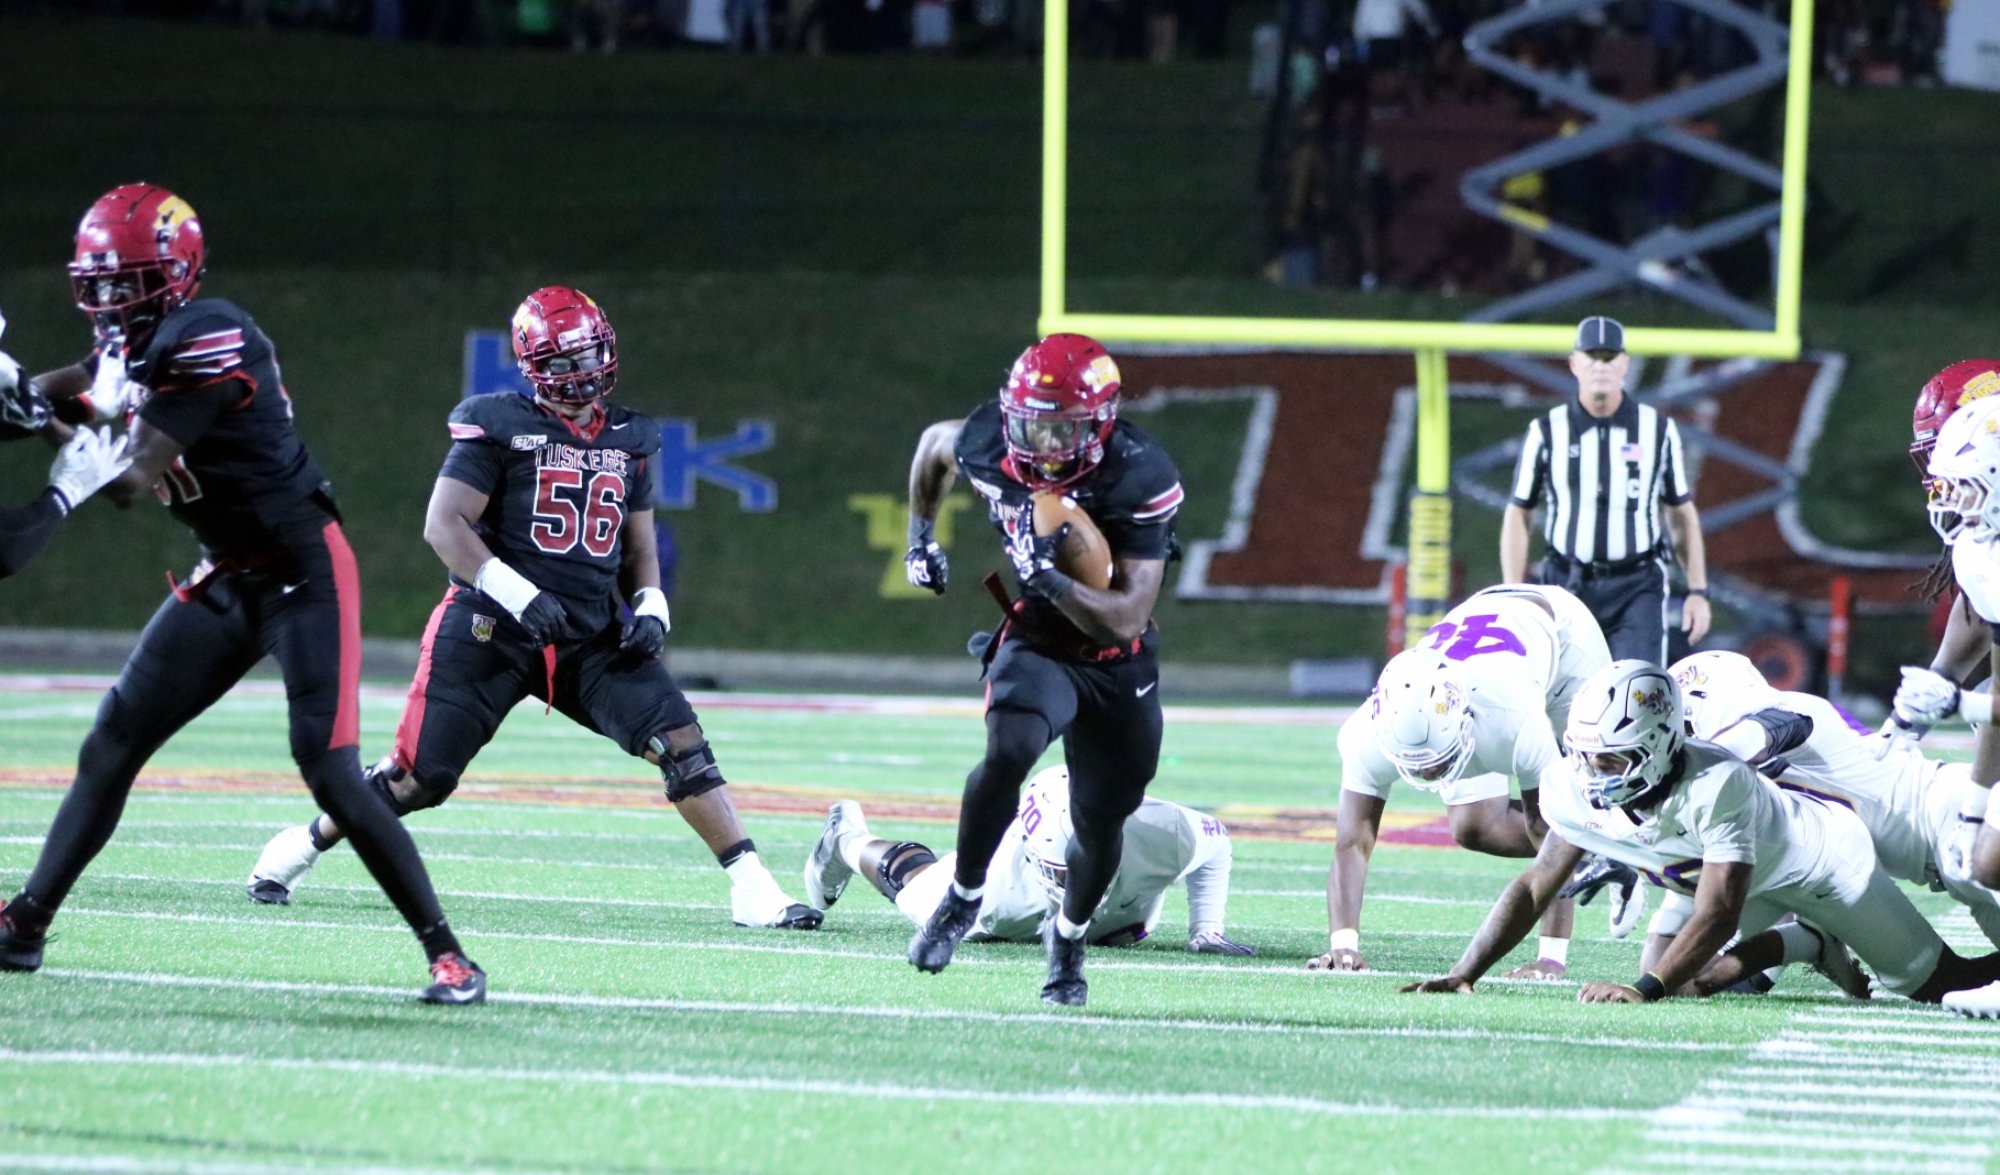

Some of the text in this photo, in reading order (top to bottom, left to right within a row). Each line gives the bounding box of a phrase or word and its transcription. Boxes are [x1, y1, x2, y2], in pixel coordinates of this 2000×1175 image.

[534, 443, 631, 477] TUSKEGEE
[530, 466, 626, 557] 56
[1021, 793, 1042, 836] 70
